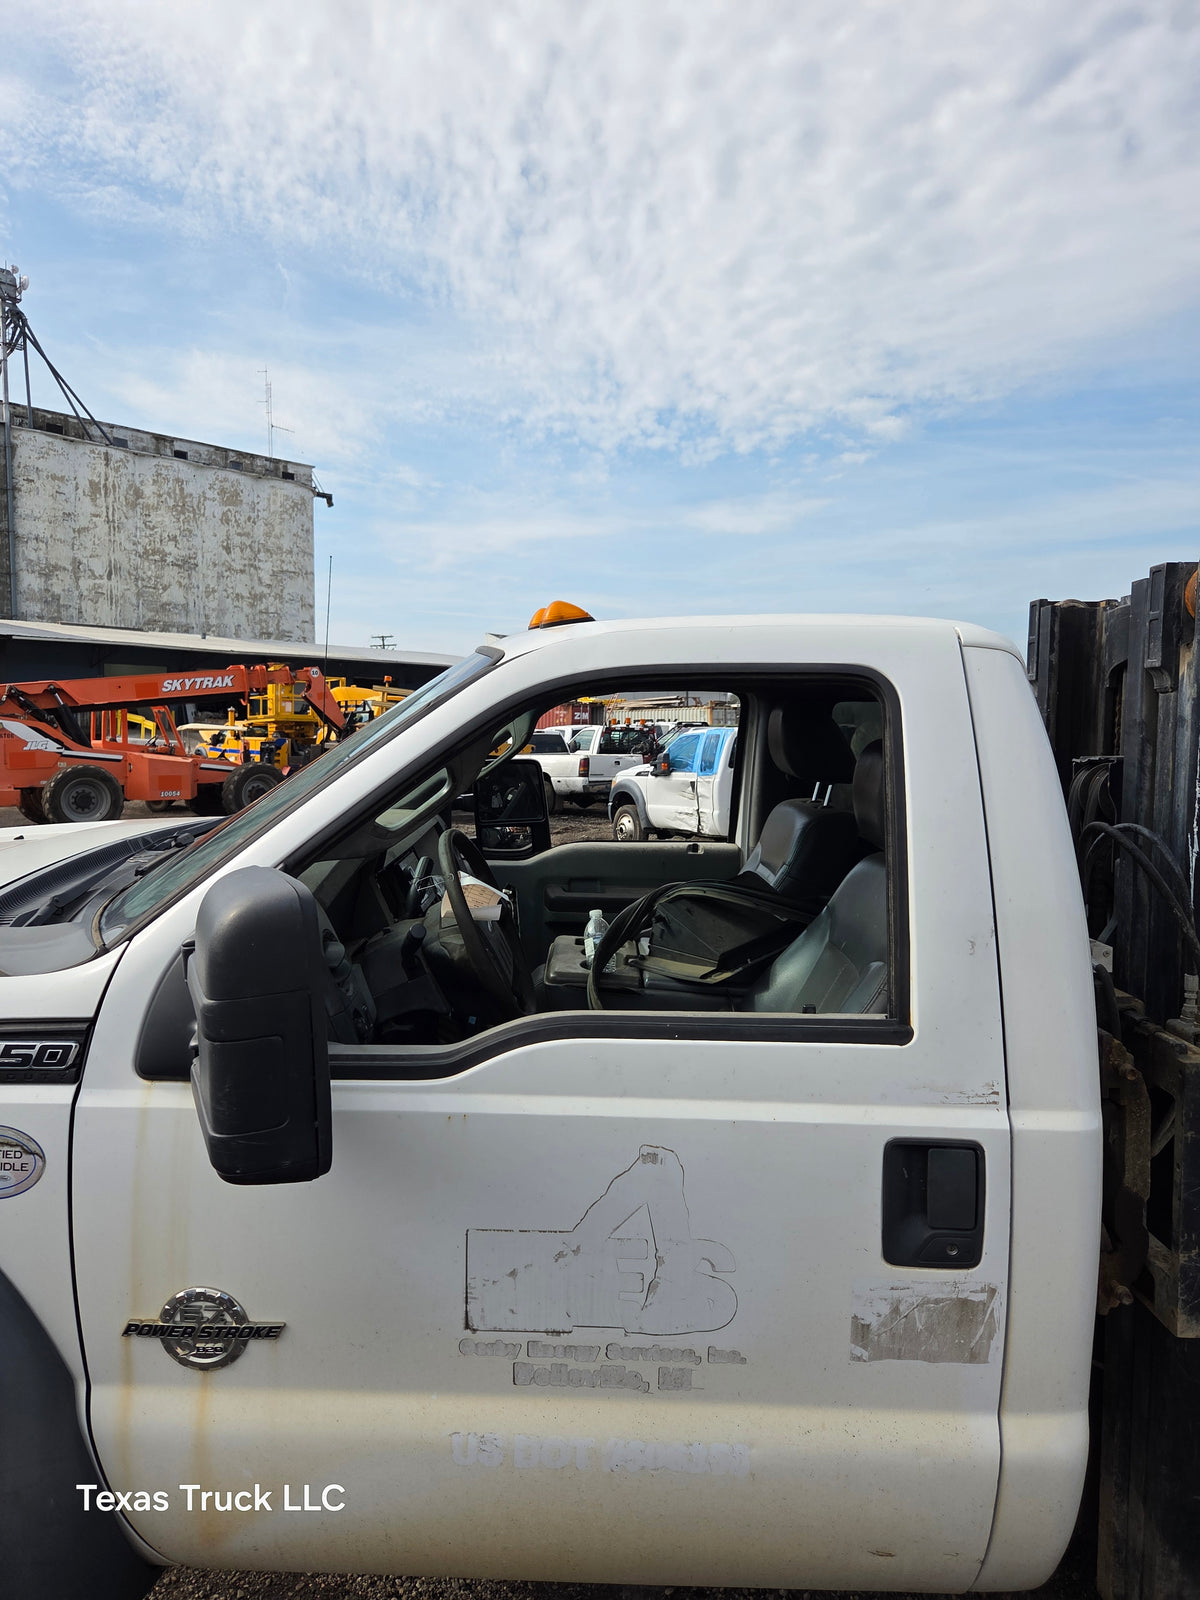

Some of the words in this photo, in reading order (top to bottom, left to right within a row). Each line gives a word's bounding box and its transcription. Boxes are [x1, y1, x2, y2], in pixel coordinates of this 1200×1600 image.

[162, 675, 235, 692] SKYTRAK
[574, 712, 590, 720] ZIM
[22, 740, 49, 750] JLG
[0, 1150, 23, 1159] IED
[0, 1162, 29, 1172] IDLE
[122, 1323, 196, 1338] POWER
[198, 1324, 284, 1340] STROKE
